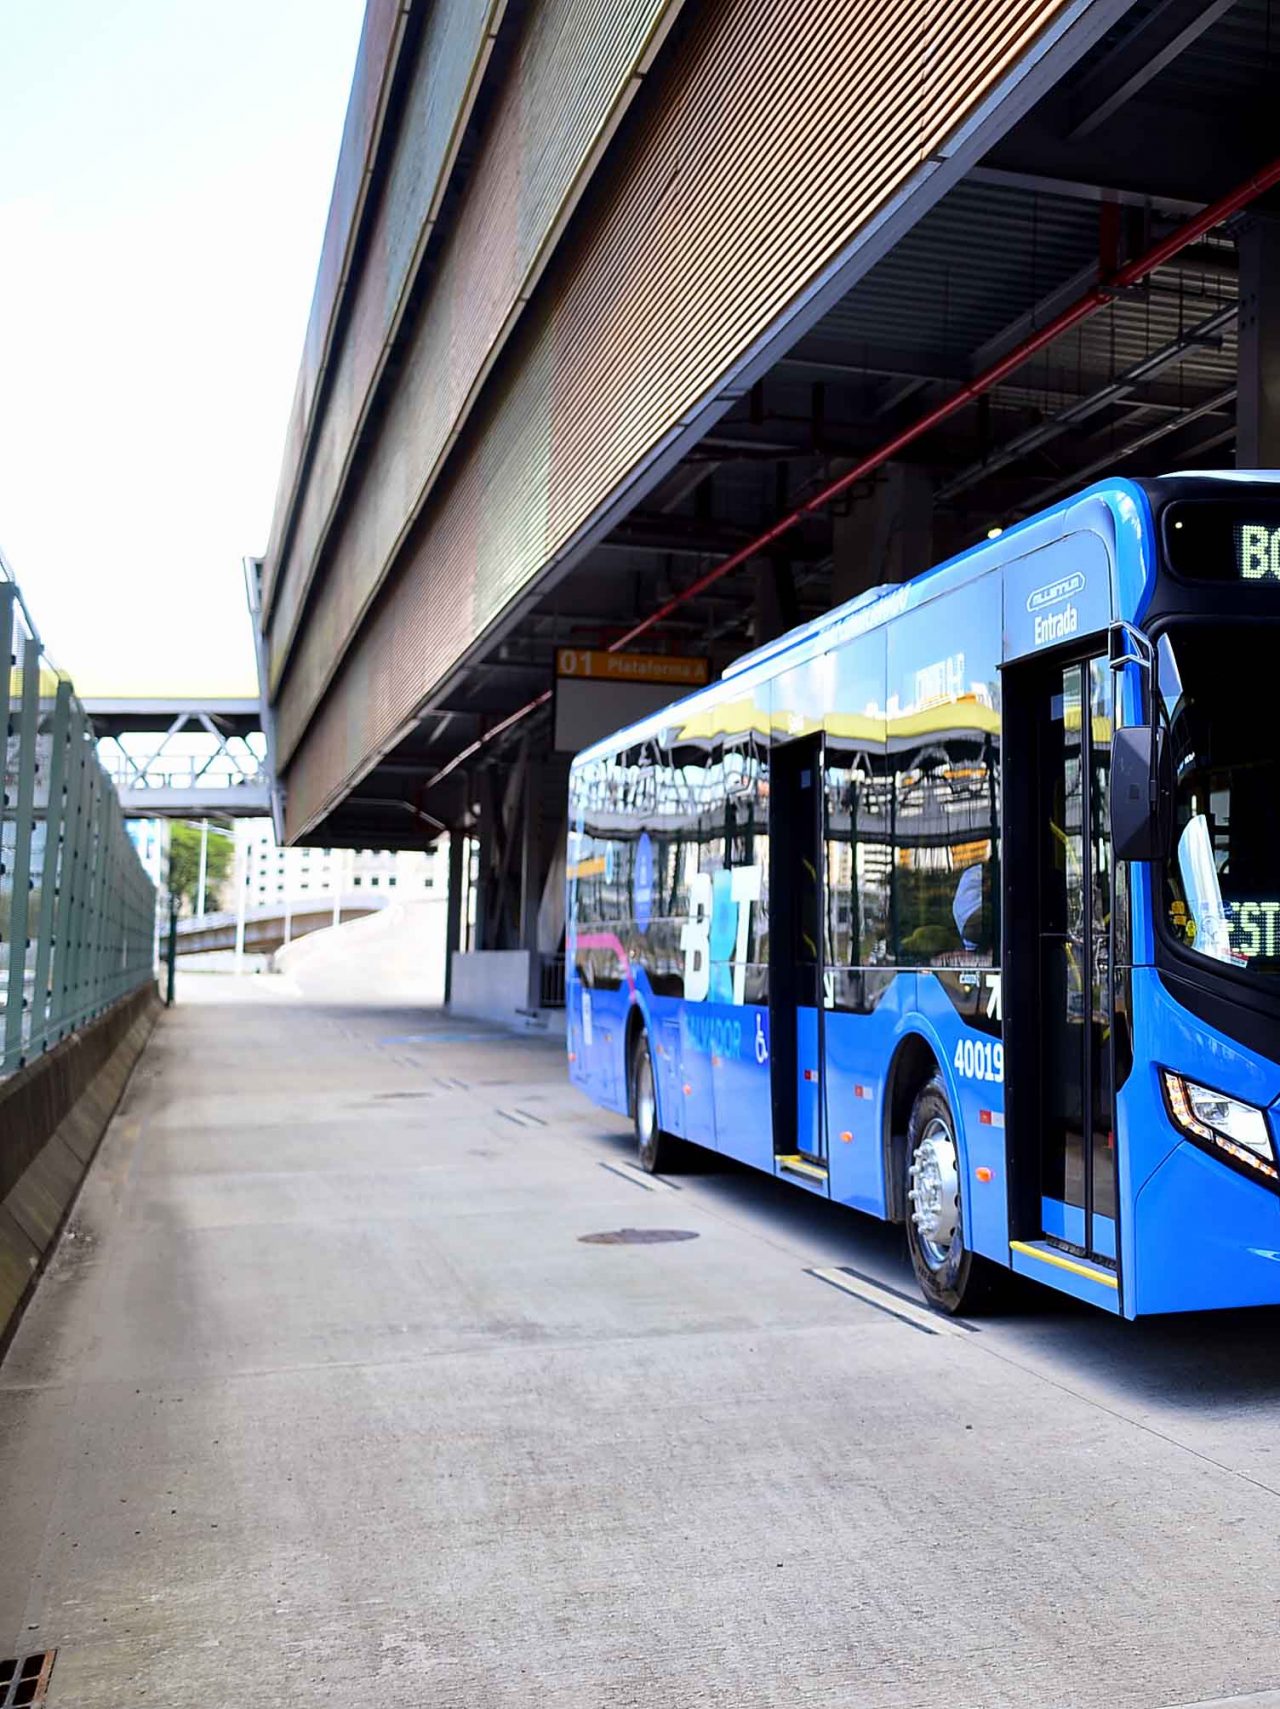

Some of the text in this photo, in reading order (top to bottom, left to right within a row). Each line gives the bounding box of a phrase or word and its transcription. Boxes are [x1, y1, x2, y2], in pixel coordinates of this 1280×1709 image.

[1034, 603, 1078, 645] Entrada
[560, 650, 592, 675] 01
[608, 659, 690, 676] Plataforma
[954, 1039, 1004, 1083] 40019
